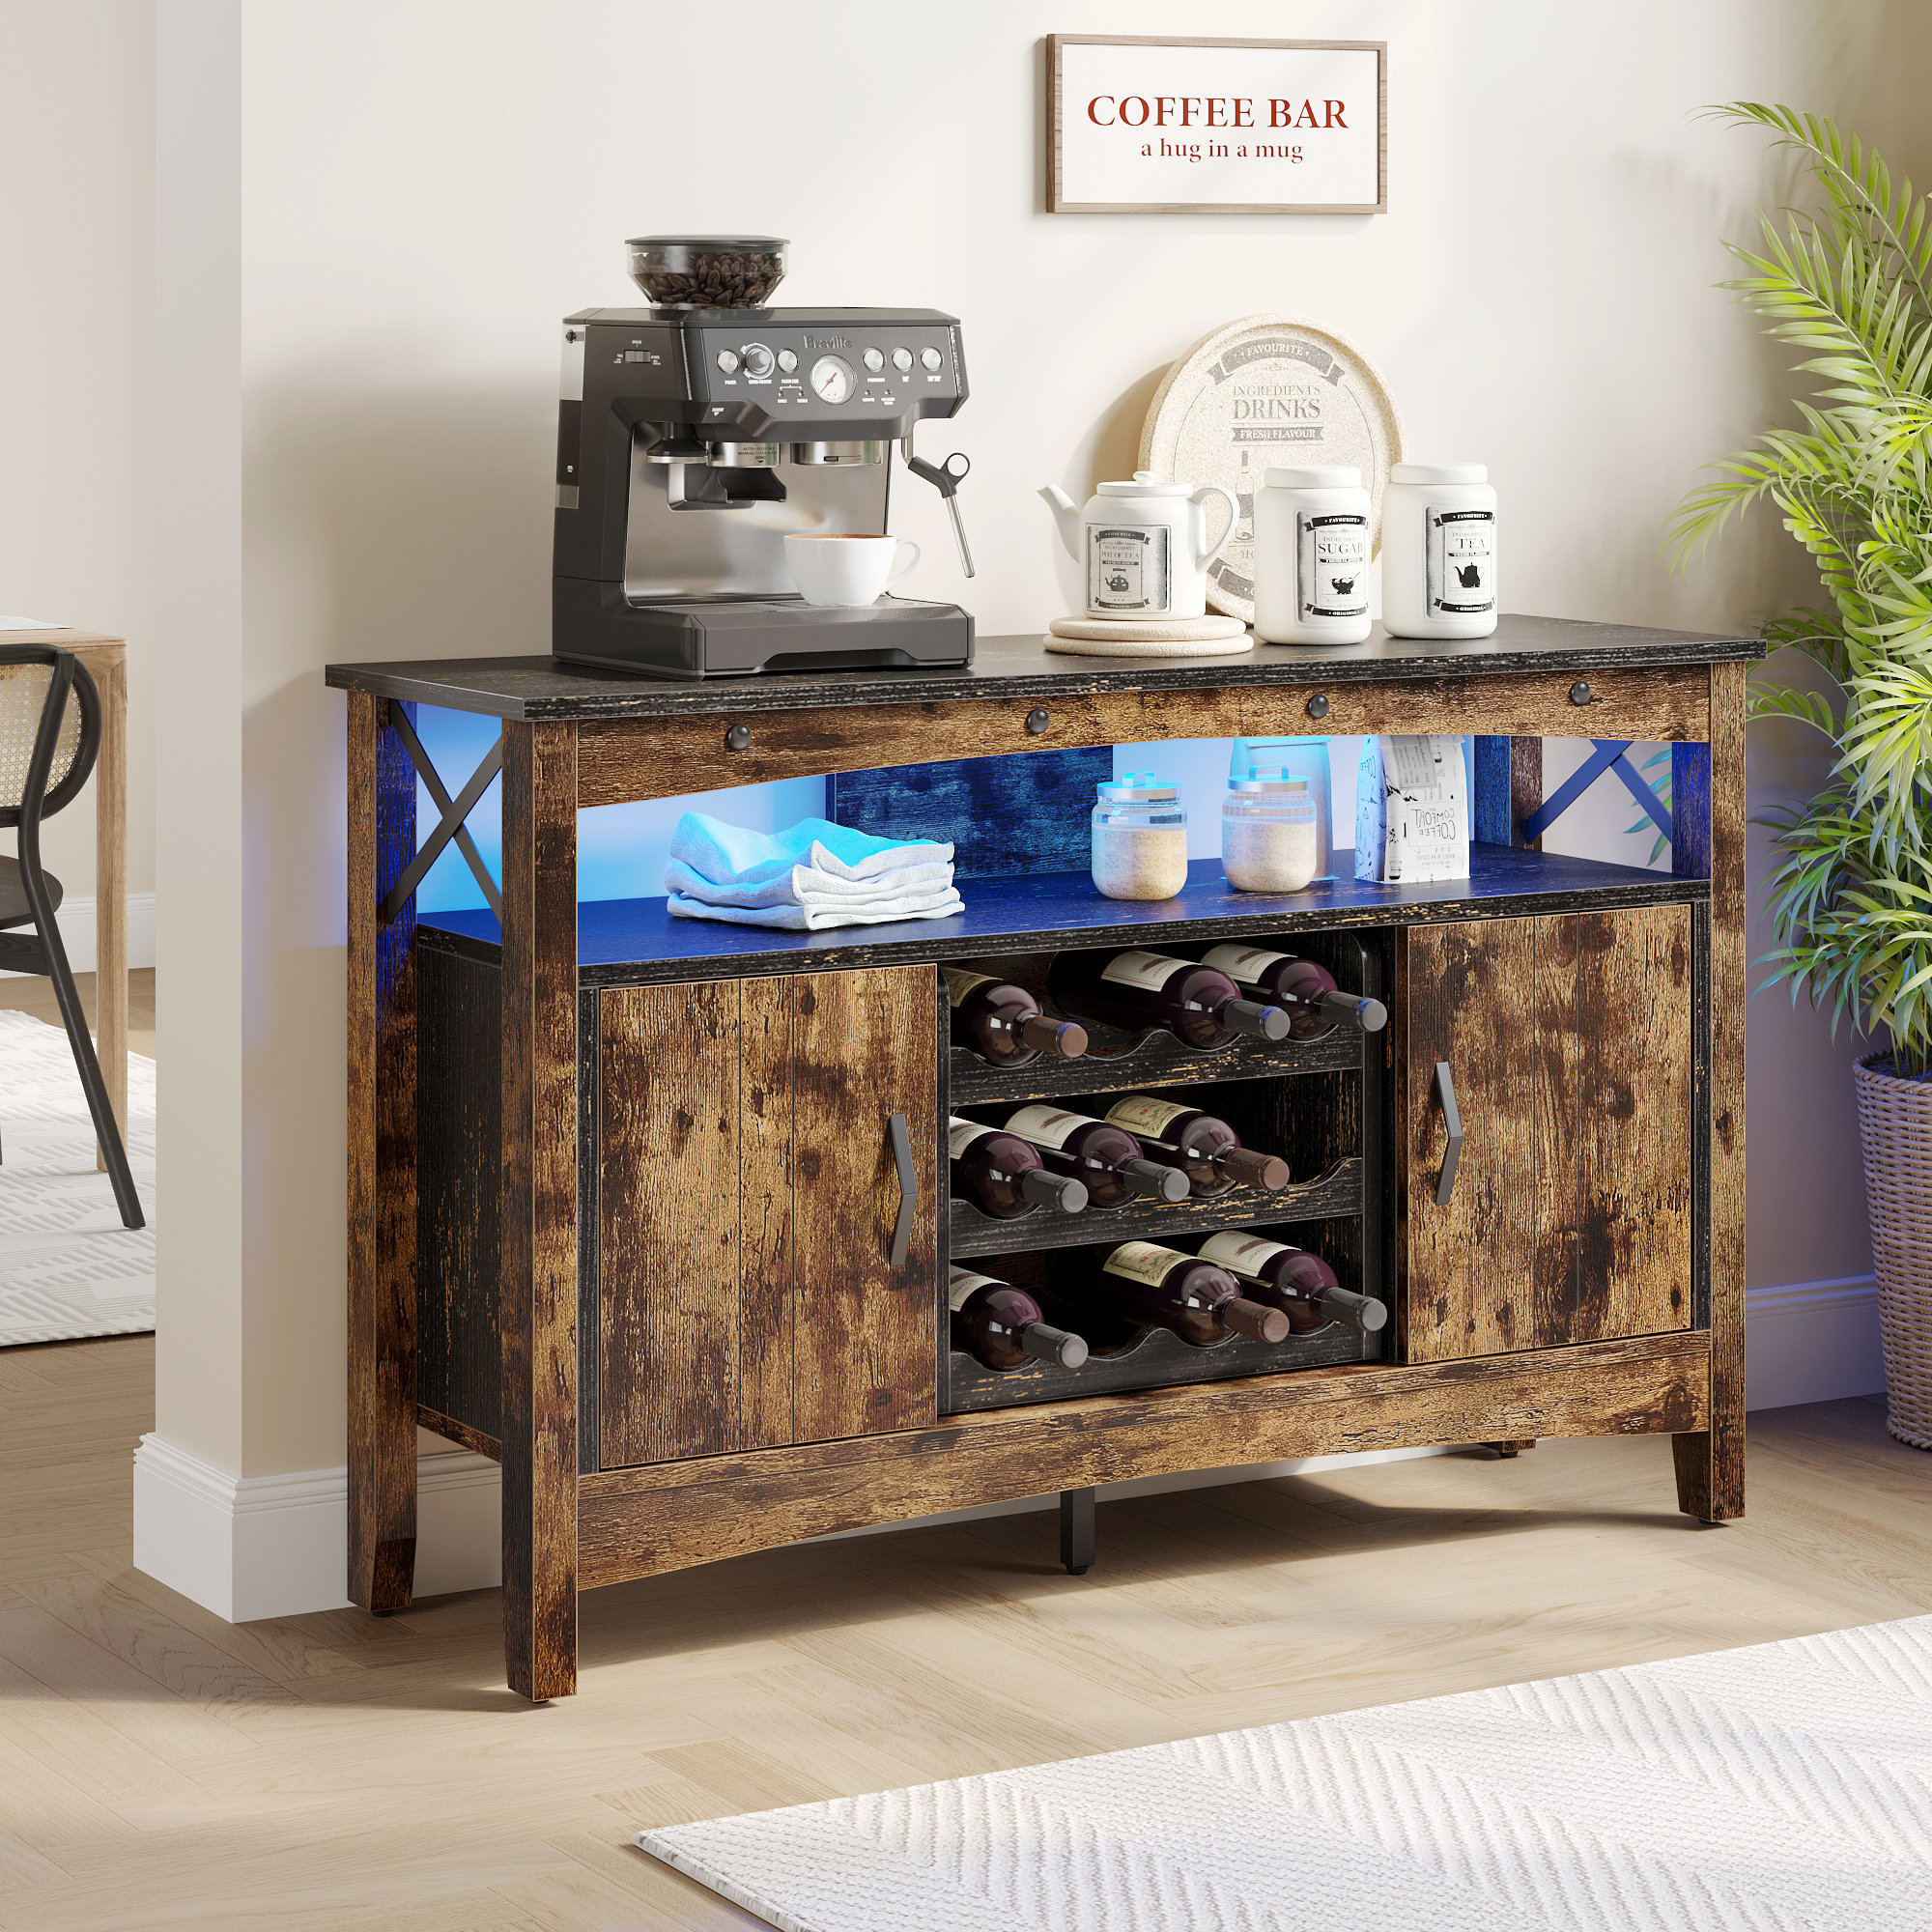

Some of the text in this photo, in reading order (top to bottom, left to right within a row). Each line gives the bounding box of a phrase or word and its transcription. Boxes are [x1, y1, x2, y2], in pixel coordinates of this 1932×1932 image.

[1087, 95, 1350, 128] COFFEE BAR
[1141, 138, 1304, 164] a hug in a mug
[803, 334, 852, 350] Breville
[1246, 343, 1303, 356] FAVOURITE
[1233, 385, 1321, 396] INGREDIENTS
[1233, 398, 1321, 419] DRINKS
[1240, 429, 1316, 440] FRESH FLAVOUR
[1318, 543, 1363, 554] SUGAR
[1455, 538, 1486, 549] TEA
